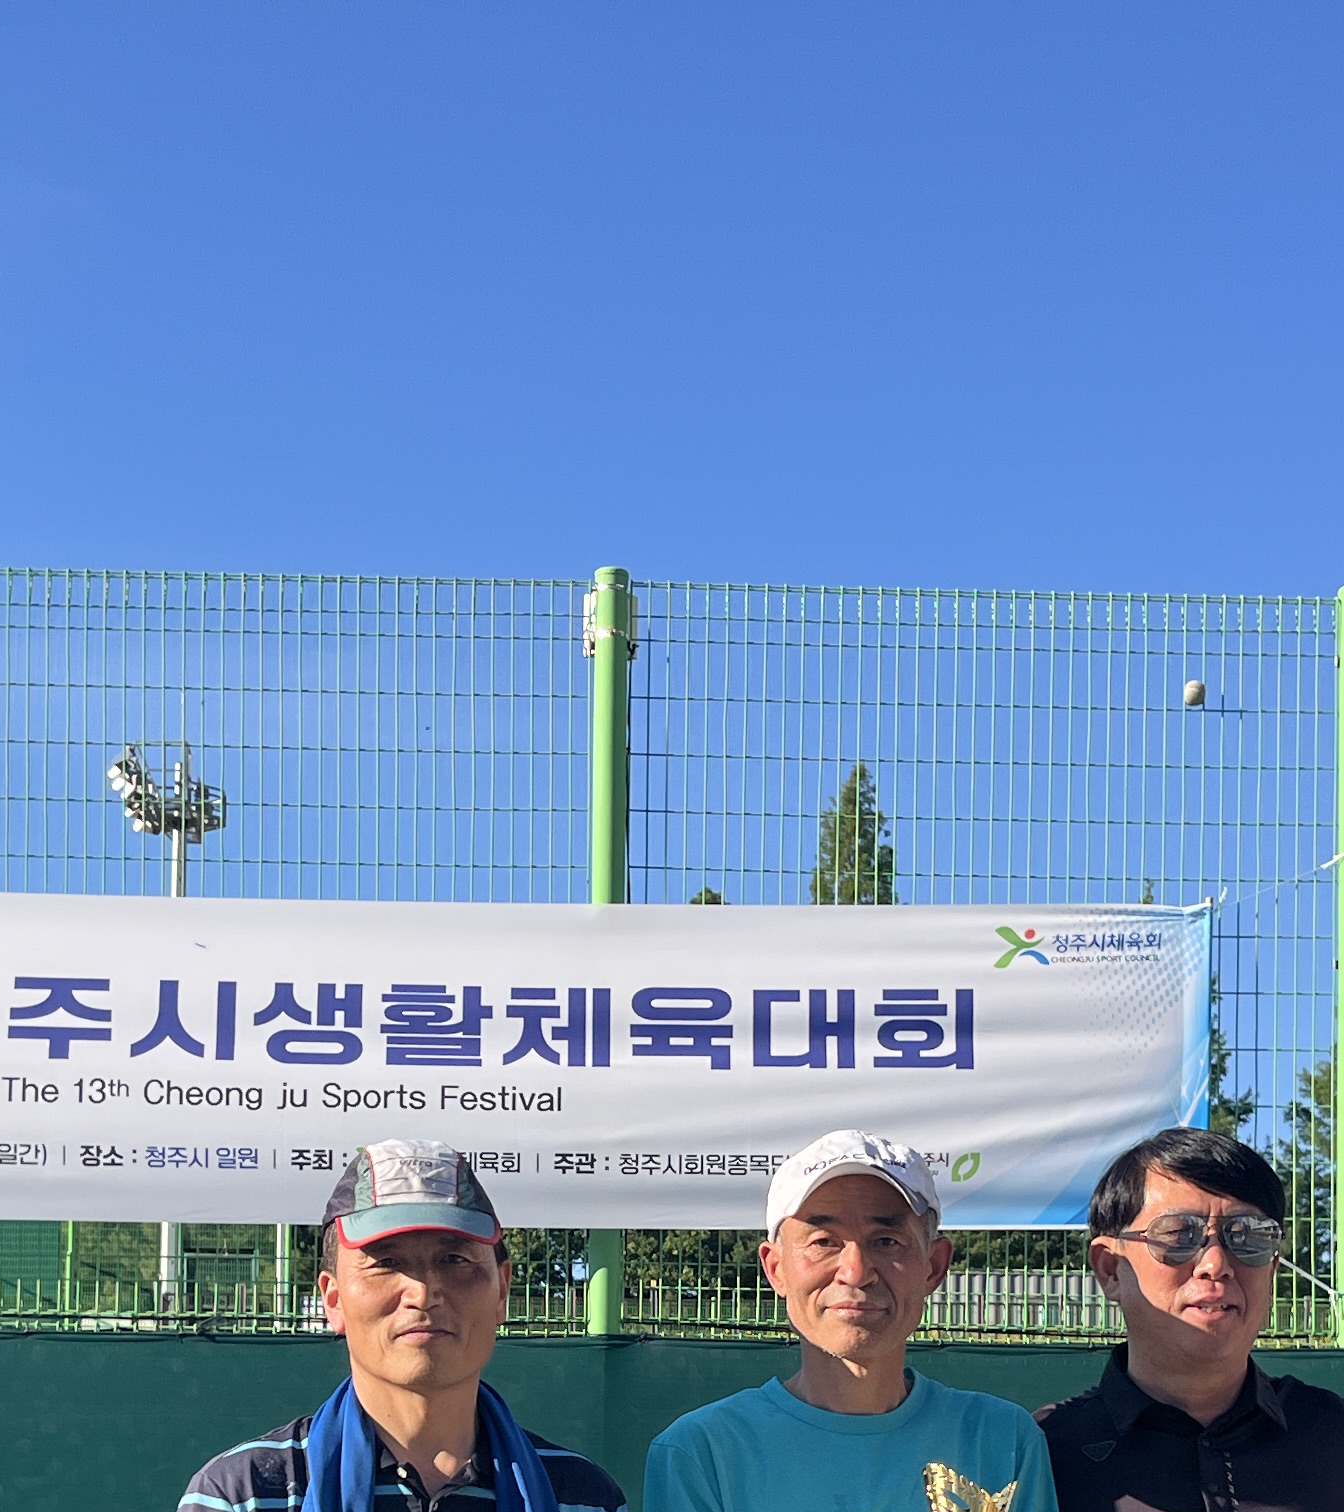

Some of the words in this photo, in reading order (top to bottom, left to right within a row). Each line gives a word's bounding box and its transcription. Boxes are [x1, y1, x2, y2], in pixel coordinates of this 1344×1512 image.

[1051, 932, 1162, 953] 청주시체육회
[1, 1076, 60, 1104] The
[73, 1077, 130, 1104] 13th
[143, 1079, 263, 1111] Cheong
[276, 1081, 308, 1110] ju
[321, 1082, 426, 1113] Sports
[440, 1084, 562, 1112] Festival
[144, 1146, 209, 1169] 청주시
[215, 1147, 259, 1170] 일원
